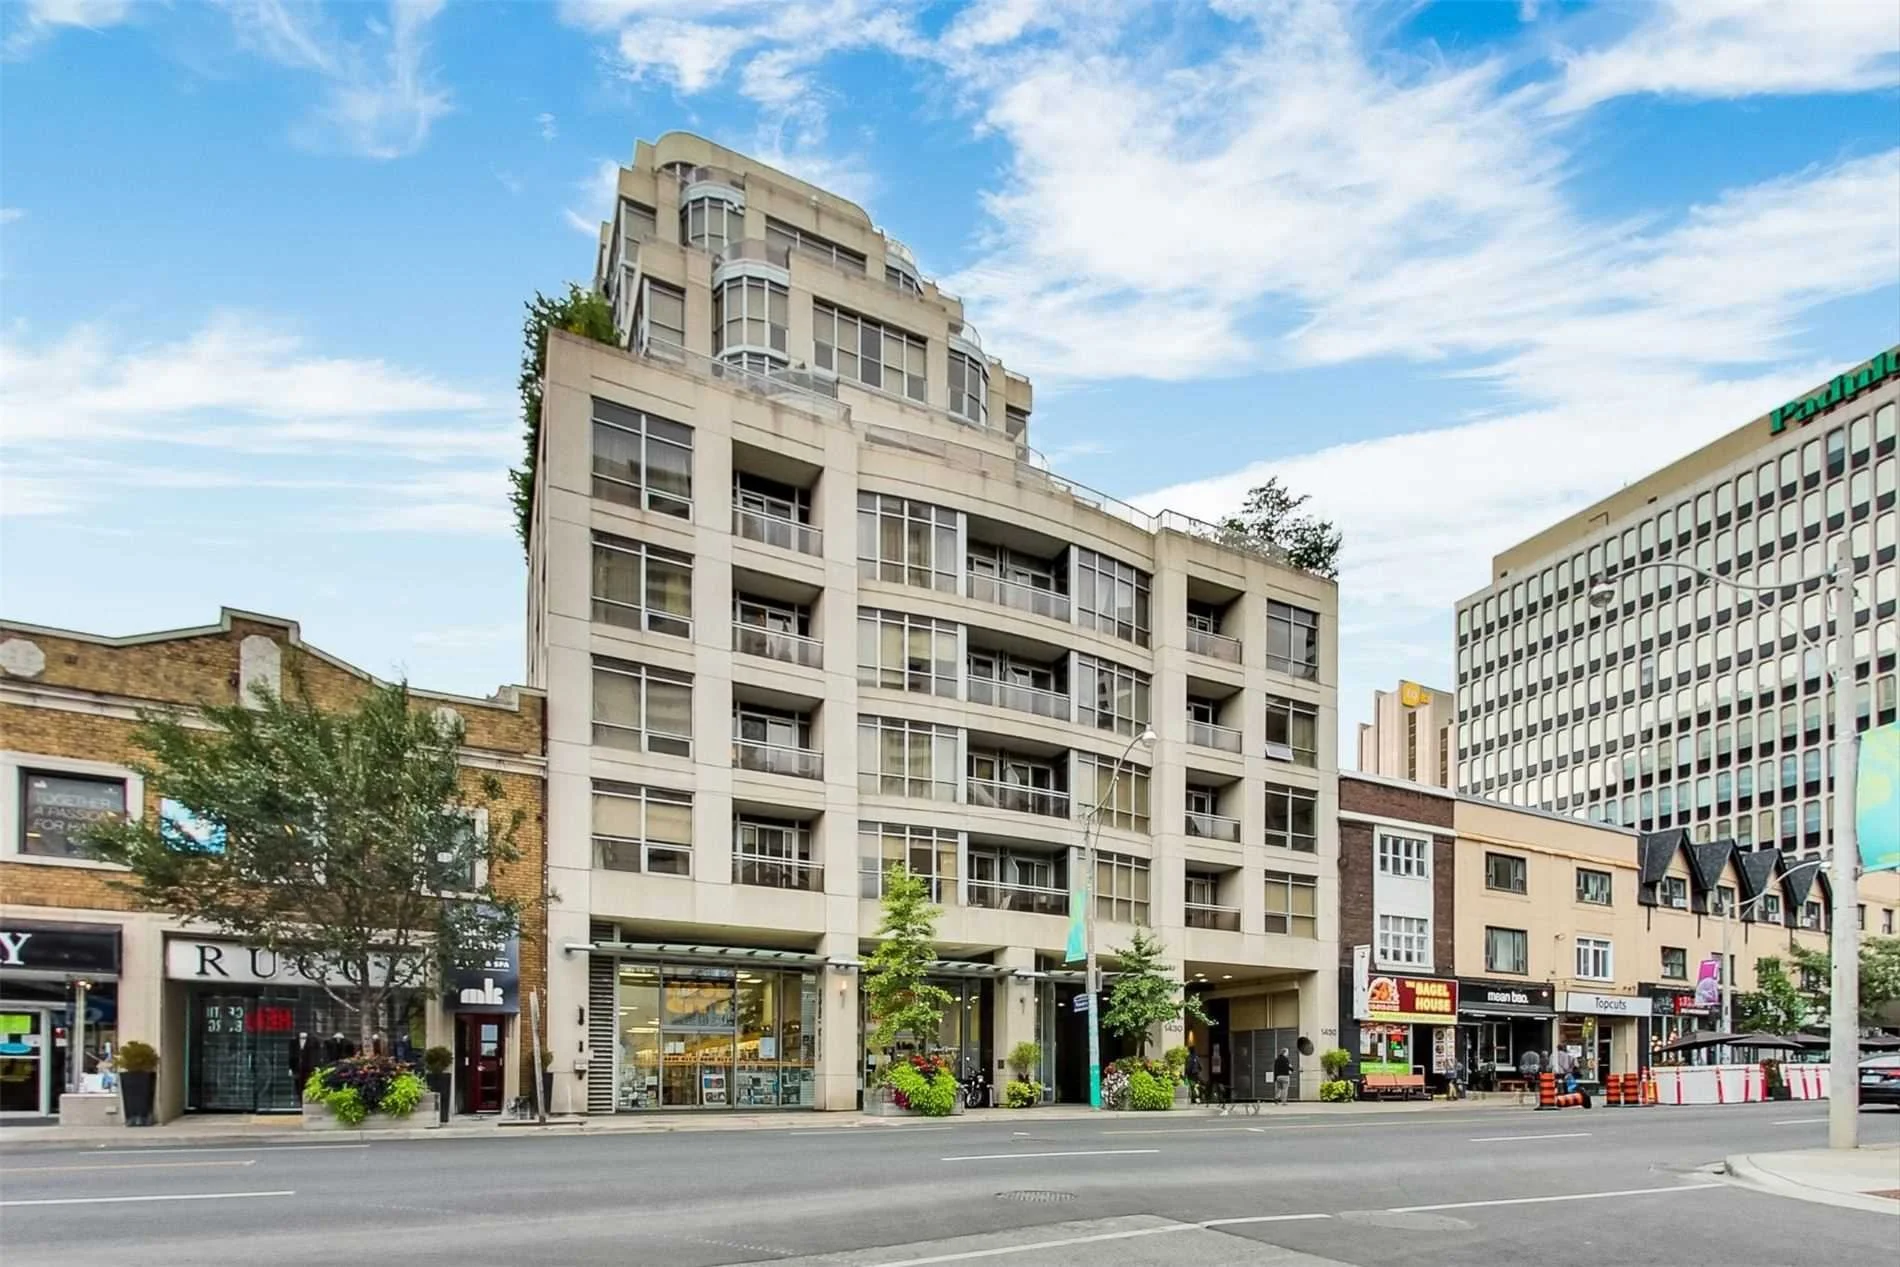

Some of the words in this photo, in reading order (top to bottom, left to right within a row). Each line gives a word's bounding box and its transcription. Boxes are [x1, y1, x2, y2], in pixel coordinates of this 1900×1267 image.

[1415, 981, 1450, 997] BAGEL
[1487, 991, 1511, 1002] mean
[1595, 997, 1627, 1010] Topcuts
[1415, 997, 1451, 1012] HOUSE
